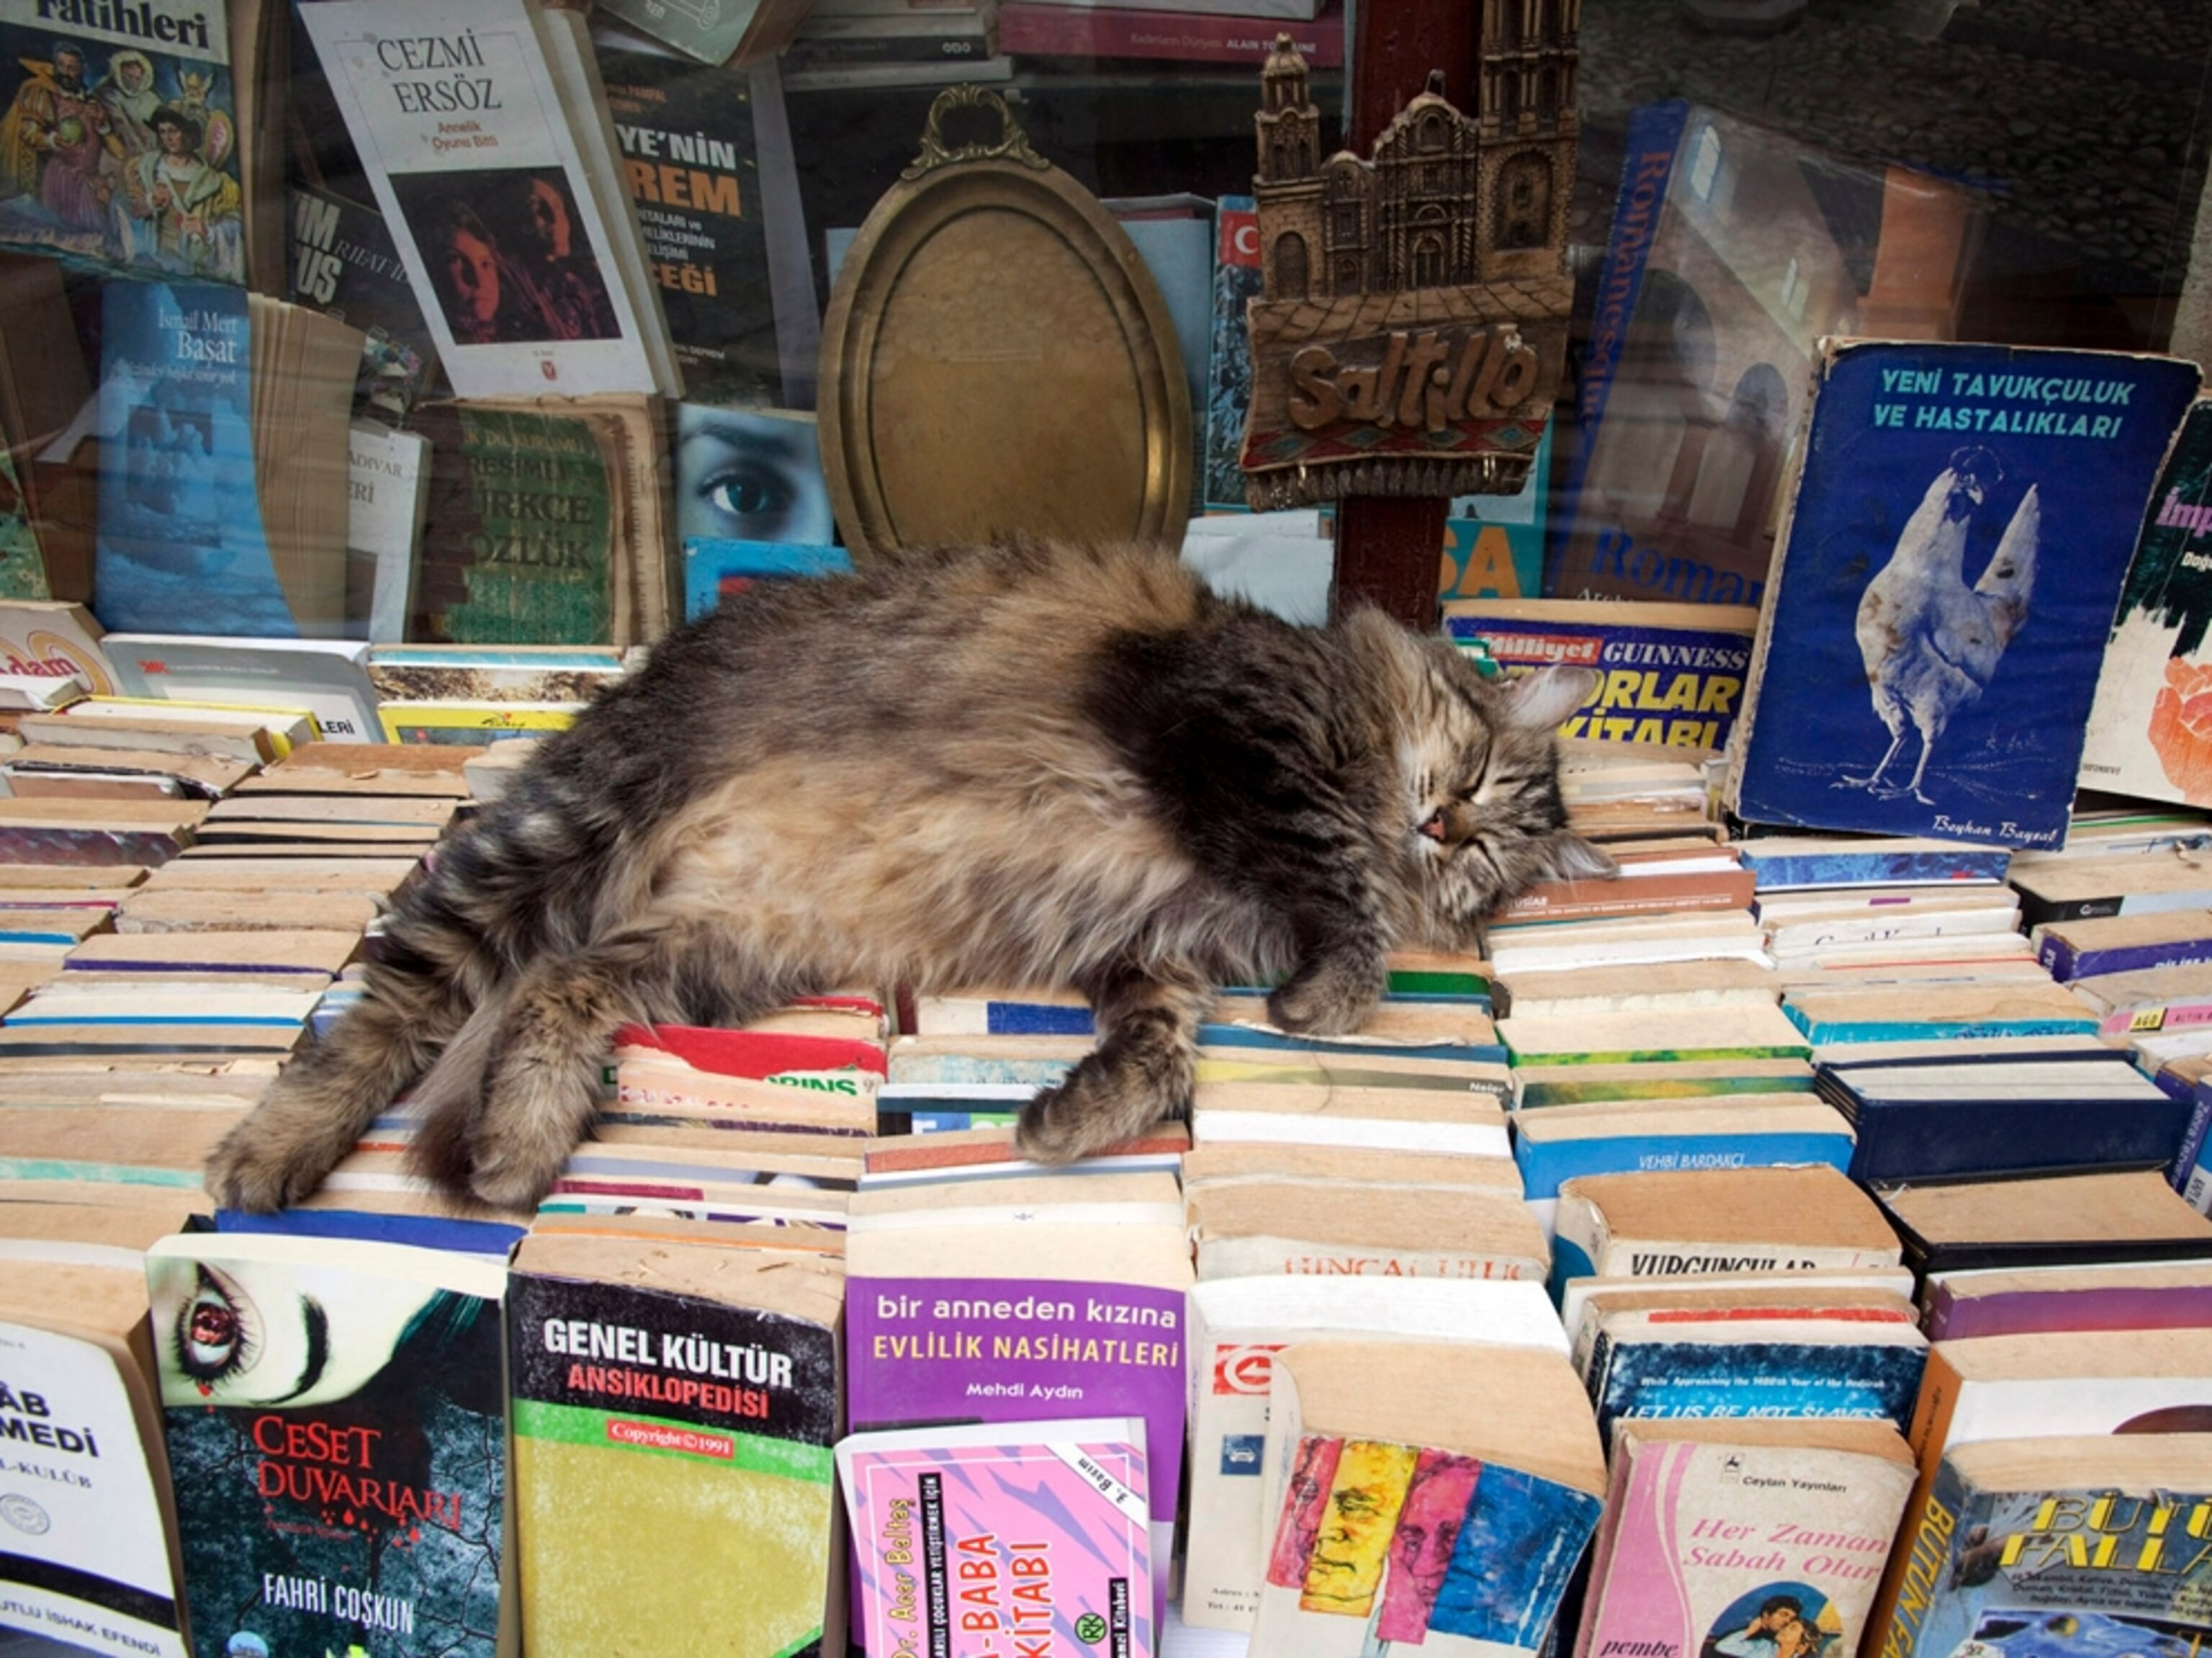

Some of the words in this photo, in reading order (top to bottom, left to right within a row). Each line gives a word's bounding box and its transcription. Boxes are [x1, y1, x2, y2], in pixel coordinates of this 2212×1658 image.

[377, 27, 485, 71] CEZMİ
[1226, 37, 1259, 50] ALAIN
[392, 73, 503, 113] ERSÖZ
[616, 123, 737, 171] YE'NİN
[624, 158, 741, 215] REM
[202, 310, 238, 333] Mert
[177, 330, 238, 369] Başat
[1288, 323, 1539, 434] Saltillo
[1881, 367, 1944, 395] YENİ
[1952, 372, 2136, 405] TAVUKÇULUK
[1873, 403, 1907, 427] VE
[1915, 405, 2123, 439] HASTALIKLARI
[1487, 635, 1594, 662] Milliyet
[1604, 642, 1750, 671] GUINNESS
[1584, 668, 1742, 713] RLAR
[1638, 1150, 1678, 1169] VEHBİ
[877, 1295, 923, 1319] bir
[932, 1296, 1075, 1321] anneden
[1087, 1298, 1177, 1330] kızına
[543, 1318, 658, 1365] GENEL
[662, 1333, 792, 1389] KÜLTÜR
[873, 1331, 984, 1360] EVLİLİK
[993, 1332, 1179, 1368] NASİHATLERİ
[567, 1363, 770, 1419] ANSİKLOPEDİSİ
[966, 1382, 1024, 1397] Mehdi
[1030, 1384, 1083, 1401] Aydın
[1622, 1406, 1668, 1418] LET
[1671, 1406, 1705, 1418] US
[252, 1415, 382, 1470] CESET
[256, 1460, 462, 1533] DUVARLARI
[1742, 1475, 1786, 1489] Ceylan
[1790, 1477, 1848, 1494] Yayınları
[881, 1498, 917, 1565] Baltaş
[1689, 1518, 1757, 1541] Her
[1768, 1523, 1889, 1554] Zaman
[1681, 1545, 1788, 1572] Sabah
[1802, 1552, 1881, 1581] Olur
[1899, 1494, 1956, 1628] BÜTÜN
[263, 1572, 328, 1614] FAHRİ
[333, 1584, 415, 1634] COŞKUN
[101, 1627, 161, 1656] EFENDİ
